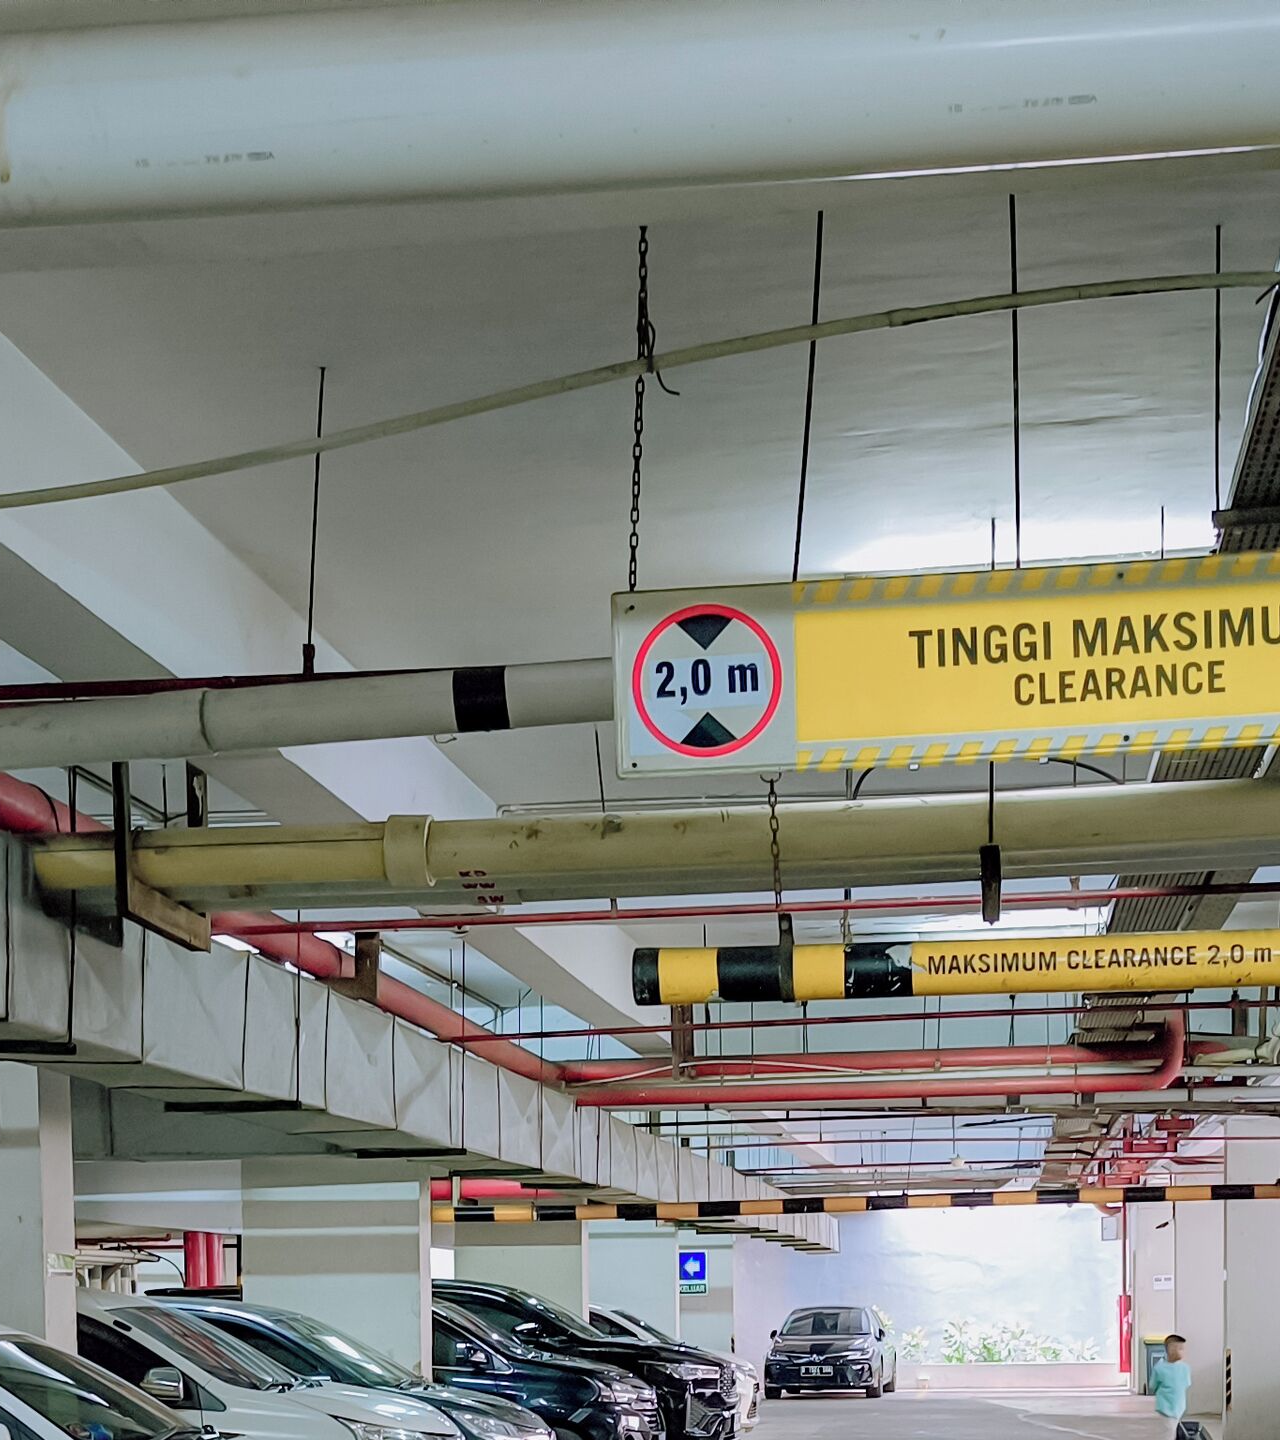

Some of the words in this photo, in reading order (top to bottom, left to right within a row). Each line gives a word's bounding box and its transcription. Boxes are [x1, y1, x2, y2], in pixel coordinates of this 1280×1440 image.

[908, 612, 1052, 669] TINGGI
[655, 658, 712, 706] 2,0
[727, 662, 759, 694] m
[1014, 660, 1226, 706] CLEARANCE
[928, 951, 1057, 975] MAKSIMUM
[1067, 946, 1197, 970] CLEARANCE
[1207, 944, 1244, 968] 2,0
[1253, 947, 1272, 963] m
